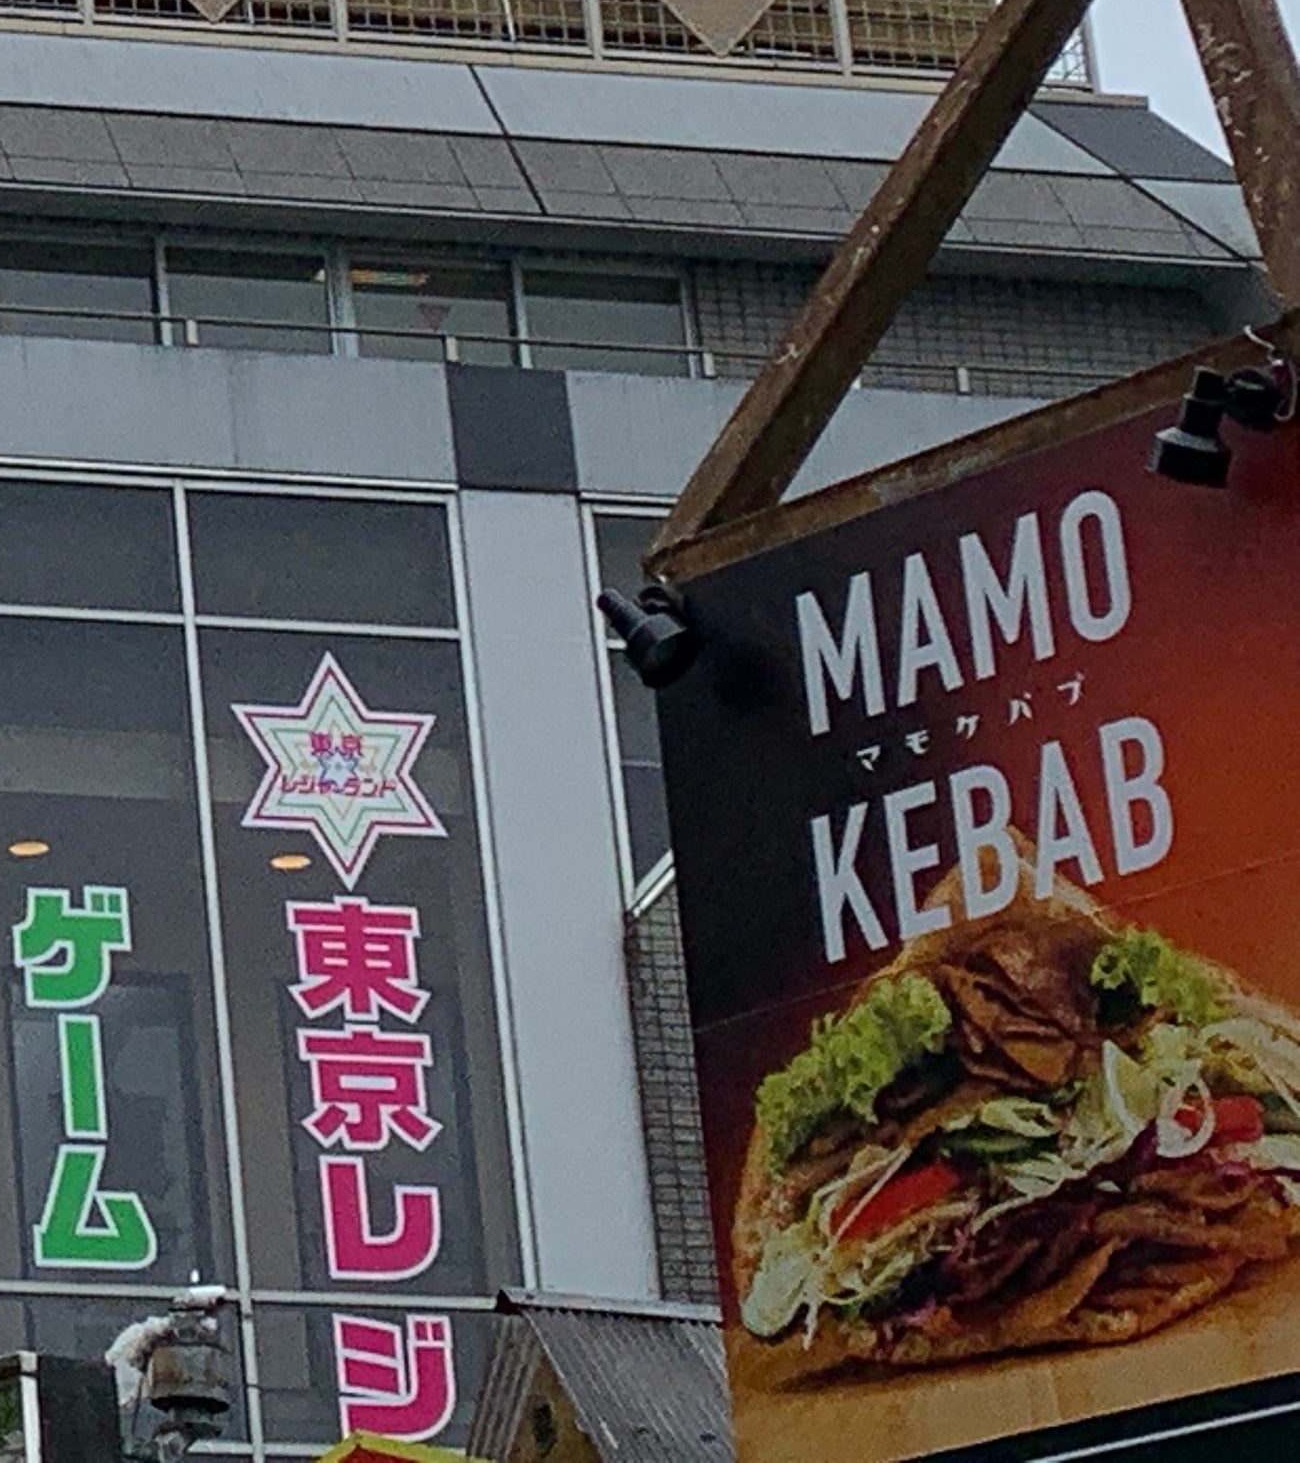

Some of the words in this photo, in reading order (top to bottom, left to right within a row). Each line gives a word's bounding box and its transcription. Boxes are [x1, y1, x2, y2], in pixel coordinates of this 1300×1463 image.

[795, 489, 1132, 735] MAMO
[309, 731, 364, 757] 東京
[810, 716, 1176, 964] KEBAB
[13, 887, 156, 1269] ゲーム
